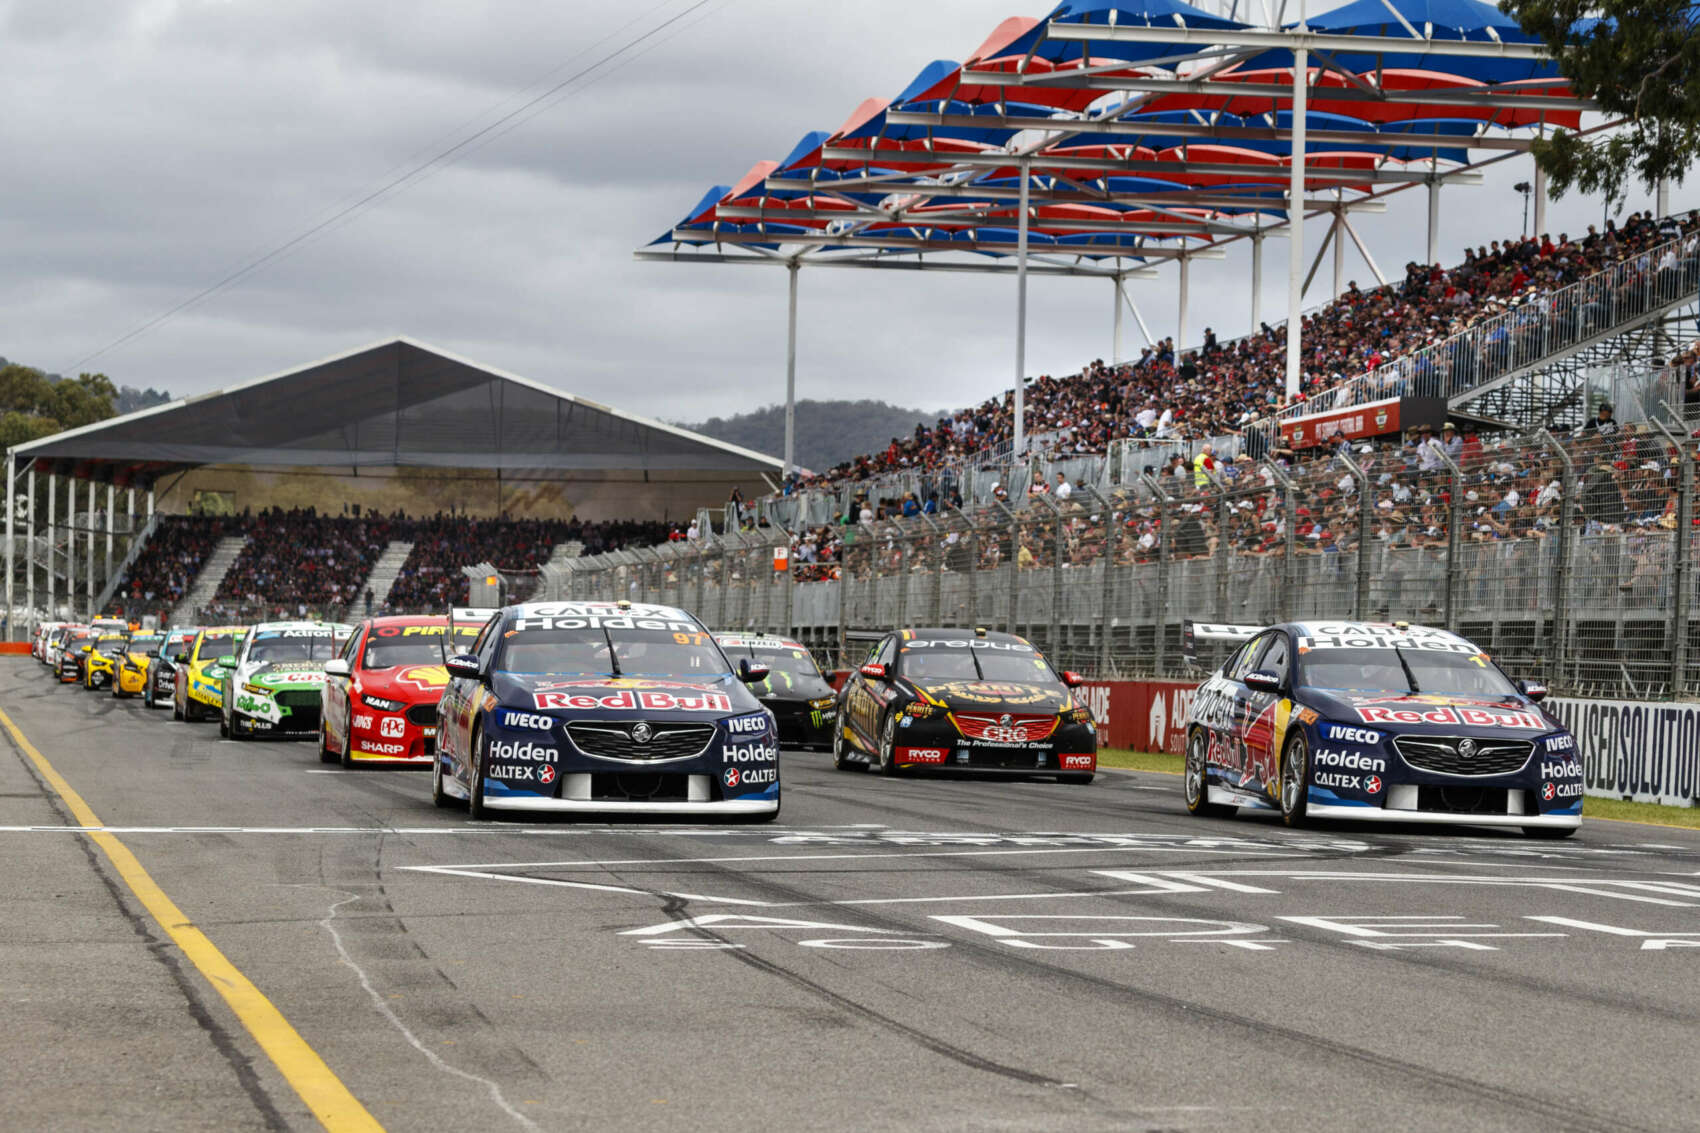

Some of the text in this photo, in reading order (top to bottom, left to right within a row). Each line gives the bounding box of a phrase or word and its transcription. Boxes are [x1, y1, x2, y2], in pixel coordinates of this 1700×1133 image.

[534, 606, 669, 618] CALTEX
[516, 617, 698, 632] Holden
[1318, 626, 1447, 639] CALTEX
[906, 639, 1033, 651] erebus
[1306, 637, 1476, 653] Holden
[534, 691, 733, 712] Red Bull
[505, 713, 553, 730] IVECO
[729, 716, 766, 733] IVECO
[1354, 706, 1547, 730] Red Bull
[1329, 725, 1380, 745] IVECO
[361, 740, 405, 754] SHARP
[489, 741, 559, 762] Holden
[1545, 735, 1573, 752] IVECO
[908, 749, 941, 758] RYCO
[1066, 756, 1091, 765] RYCO
[1315, 749, 1386, 772] Holden
[489, 764, 534, 780] CALTEX
[1314, 771, 1361, 789] CALTEX
